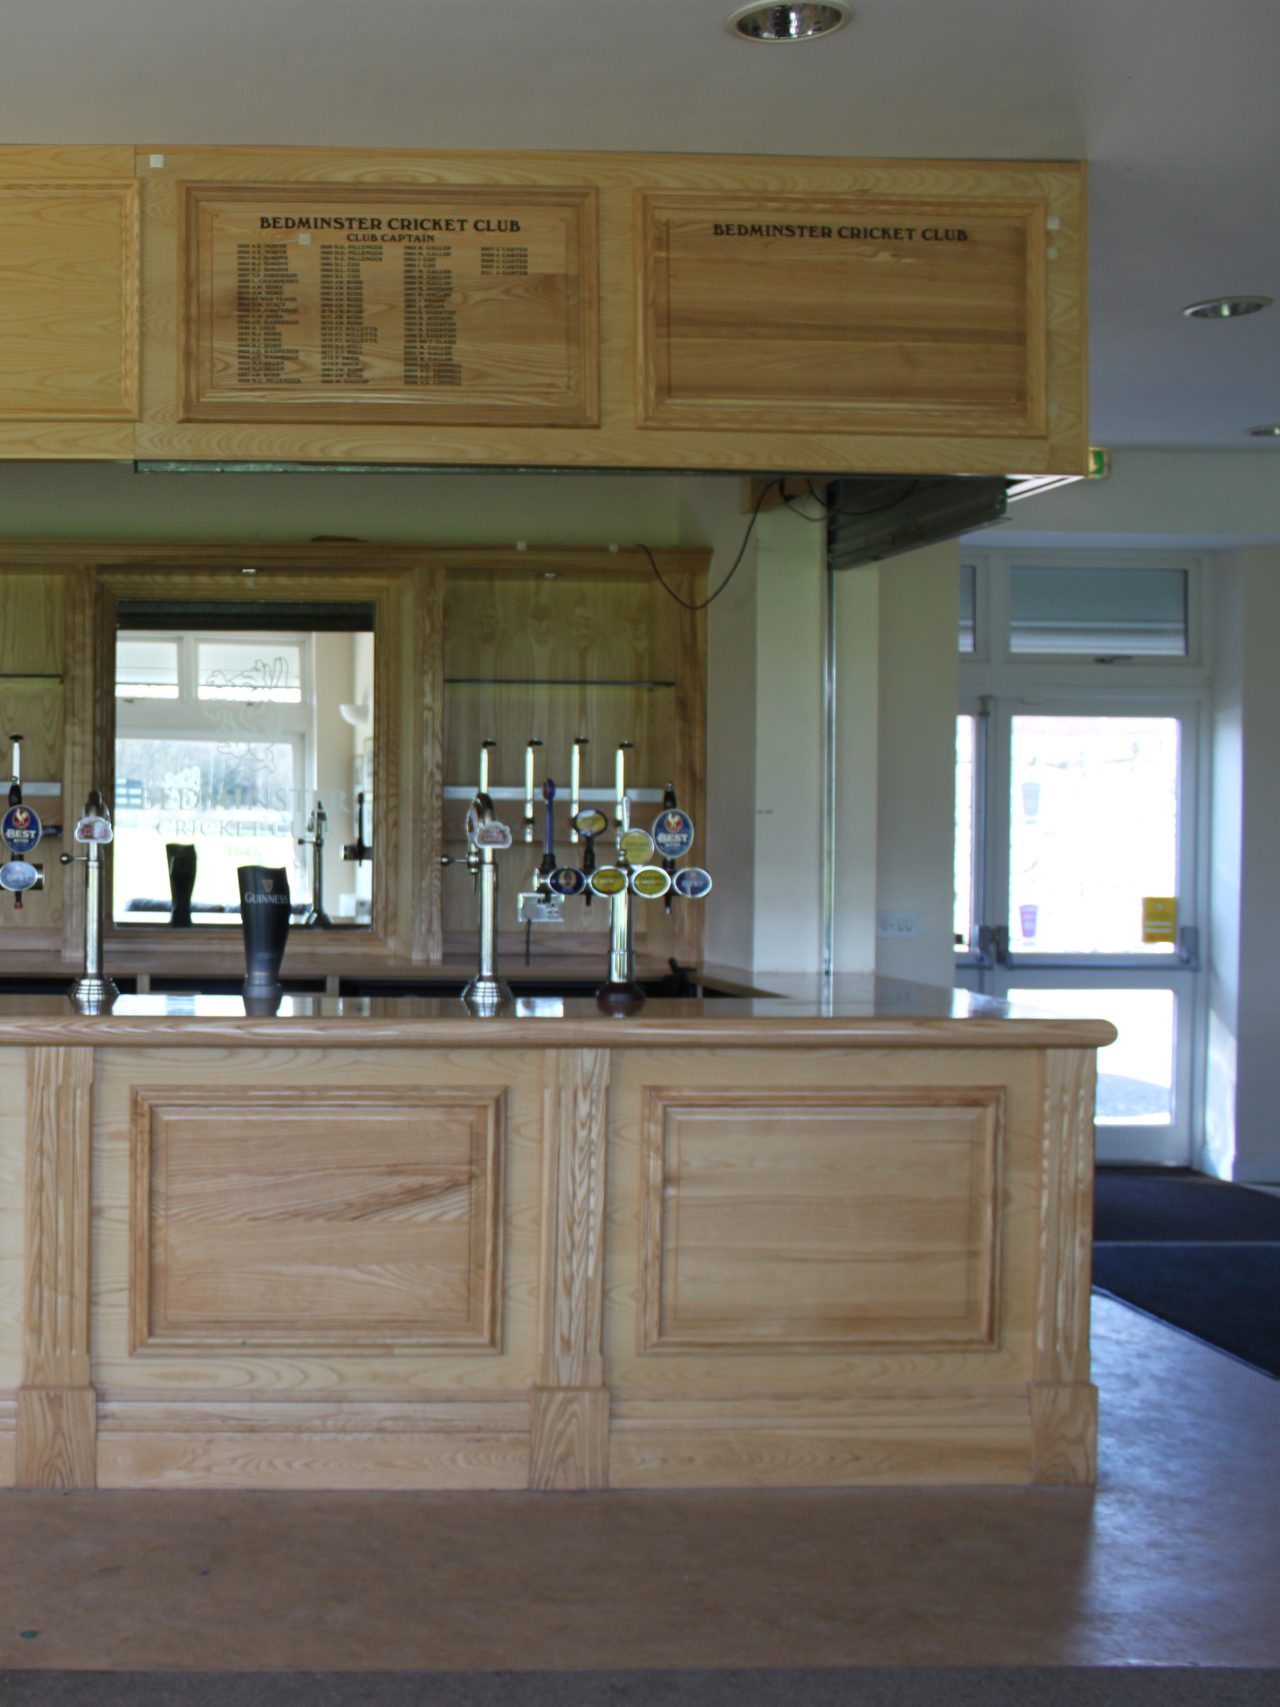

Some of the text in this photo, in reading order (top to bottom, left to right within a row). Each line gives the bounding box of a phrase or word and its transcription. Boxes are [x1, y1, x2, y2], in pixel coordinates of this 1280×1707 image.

[260, 216, 521, 233] BEDMINSTER CRICKET CLUB
[346, 233, 435, 243] CLUB CAPTAIN
[713, 223, 968, 241] BEDMINSTER CRICKET CLUB
[142, 787, 349, 813] BEDMINSTR
[5, 828, 37, 839] BEST
[244, 892, 288, 904] GUINNESS
